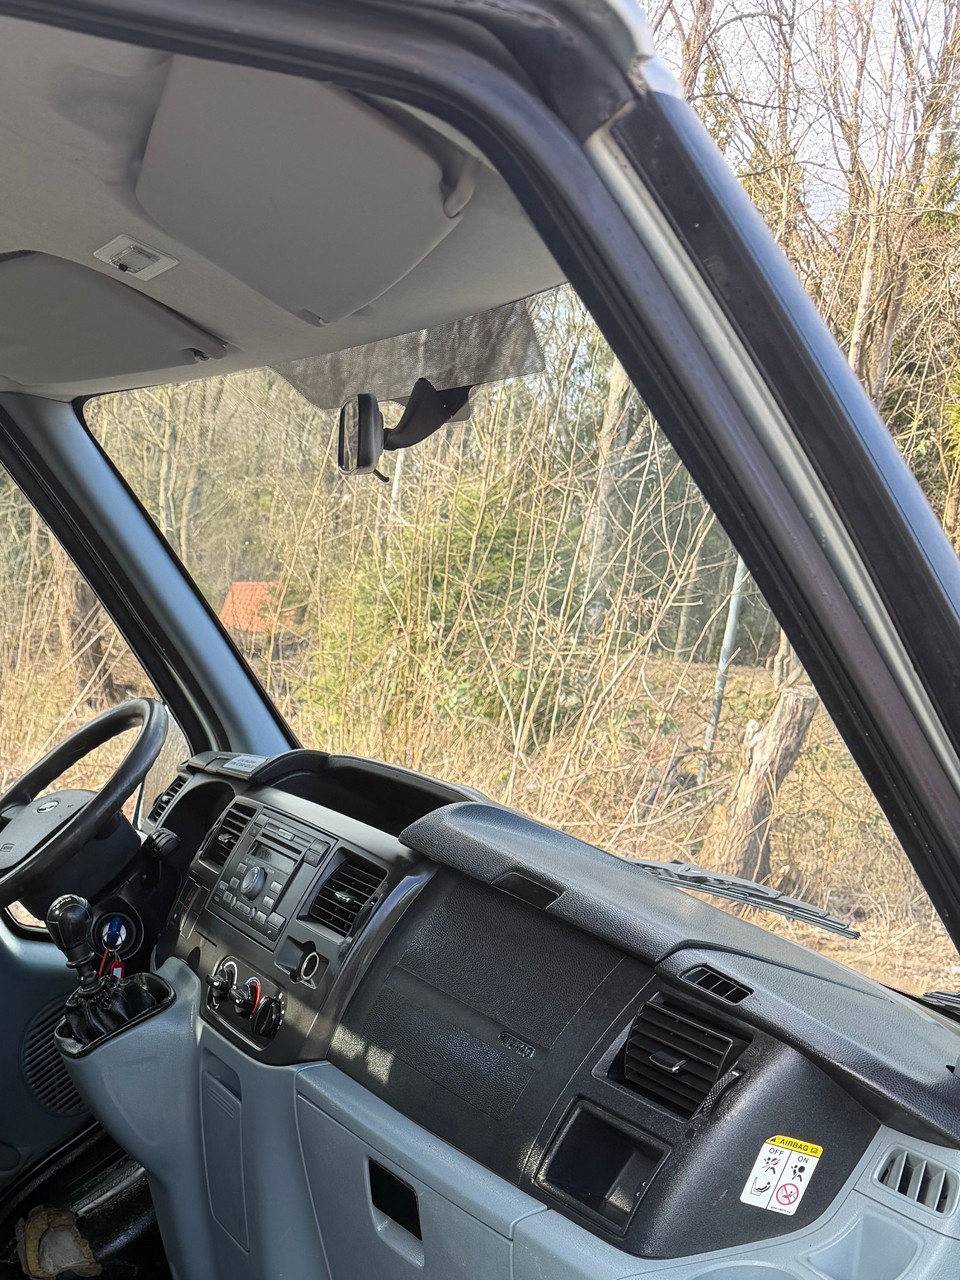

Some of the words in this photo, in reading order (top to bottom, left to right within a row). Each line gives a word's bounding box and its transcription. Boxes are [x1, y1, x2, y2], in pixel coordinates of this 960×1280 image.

[780, 1138, 809, 1152] AIRBAG
[768, 1147, 784, 1156] OFF
[797, 1156, 809, 1164] ON
